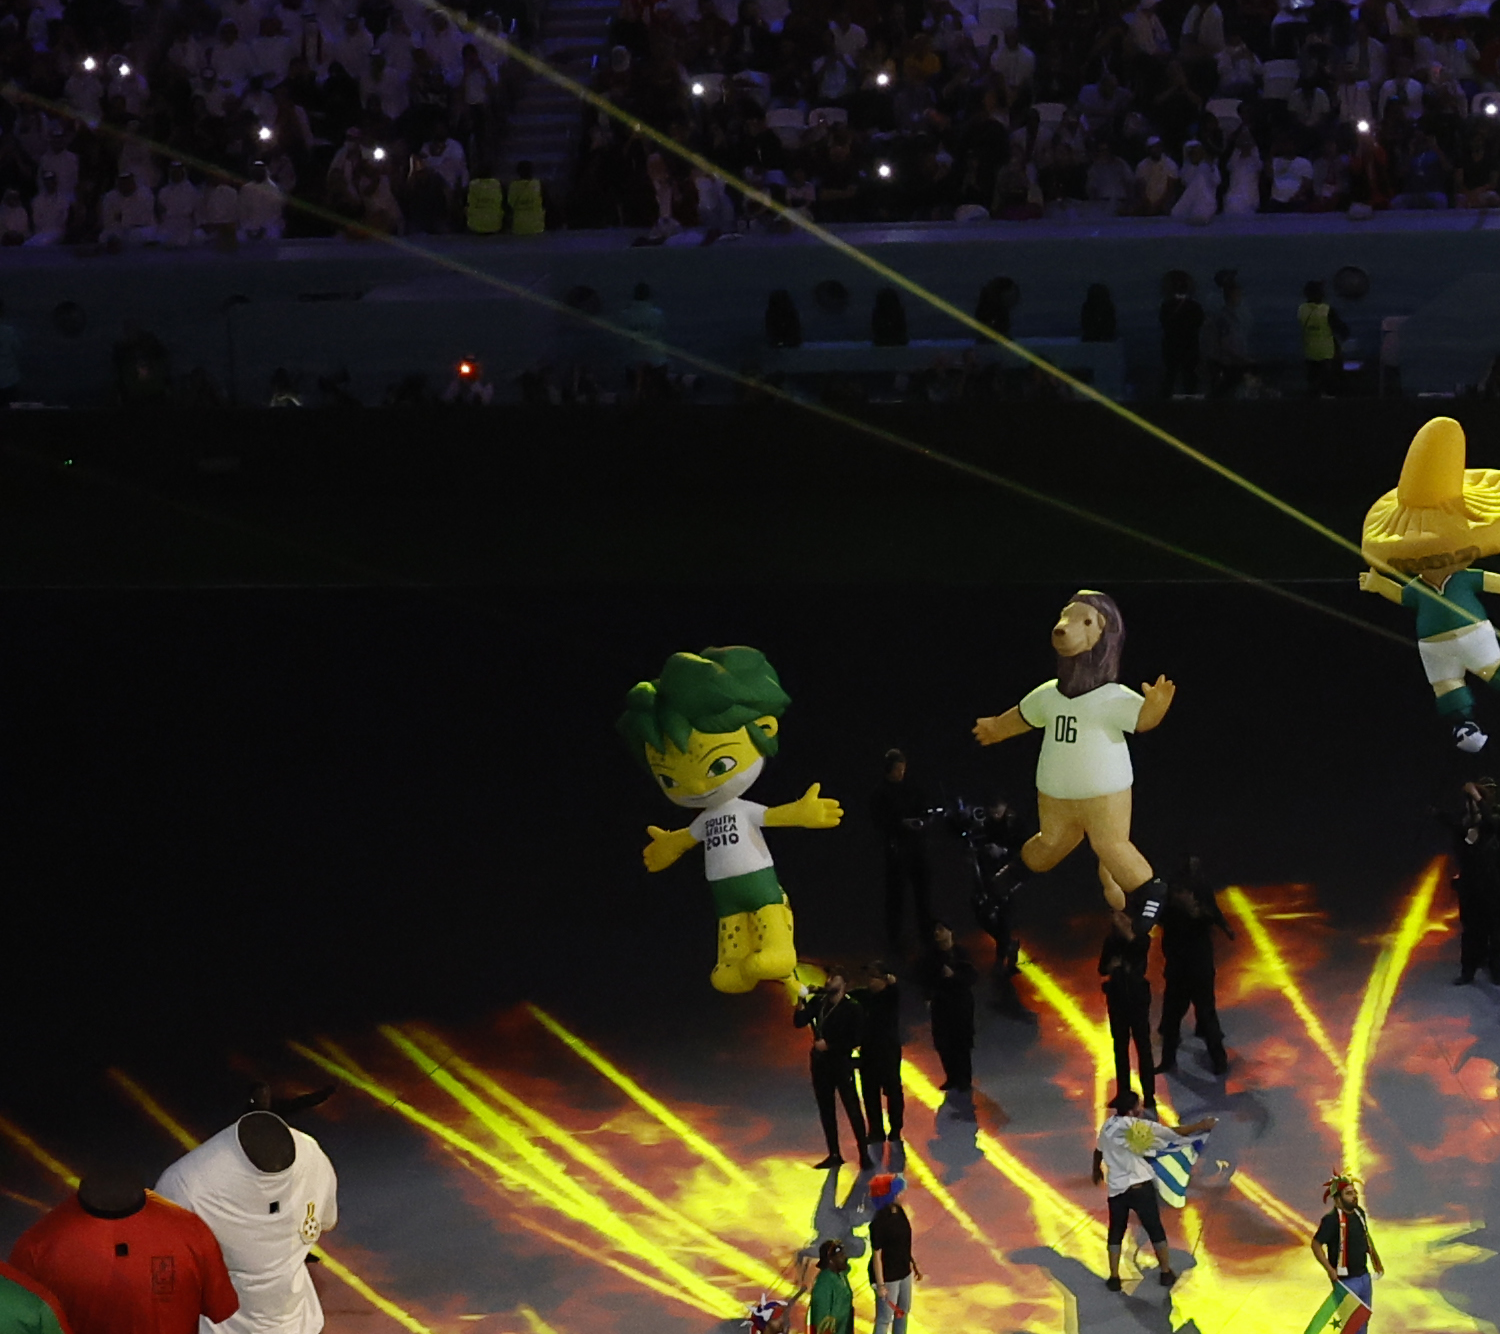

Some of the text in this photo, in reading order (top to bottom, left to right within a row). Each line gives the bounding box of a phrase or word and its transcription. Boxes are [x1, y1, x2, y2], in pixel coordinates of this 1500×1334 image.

[1054, 715, 1078, 744] 06
[705, 814, 737, 827] SOUTH
[705, 825, 737, 836] AFRICA
[706, 833, 738, 851] 2010
